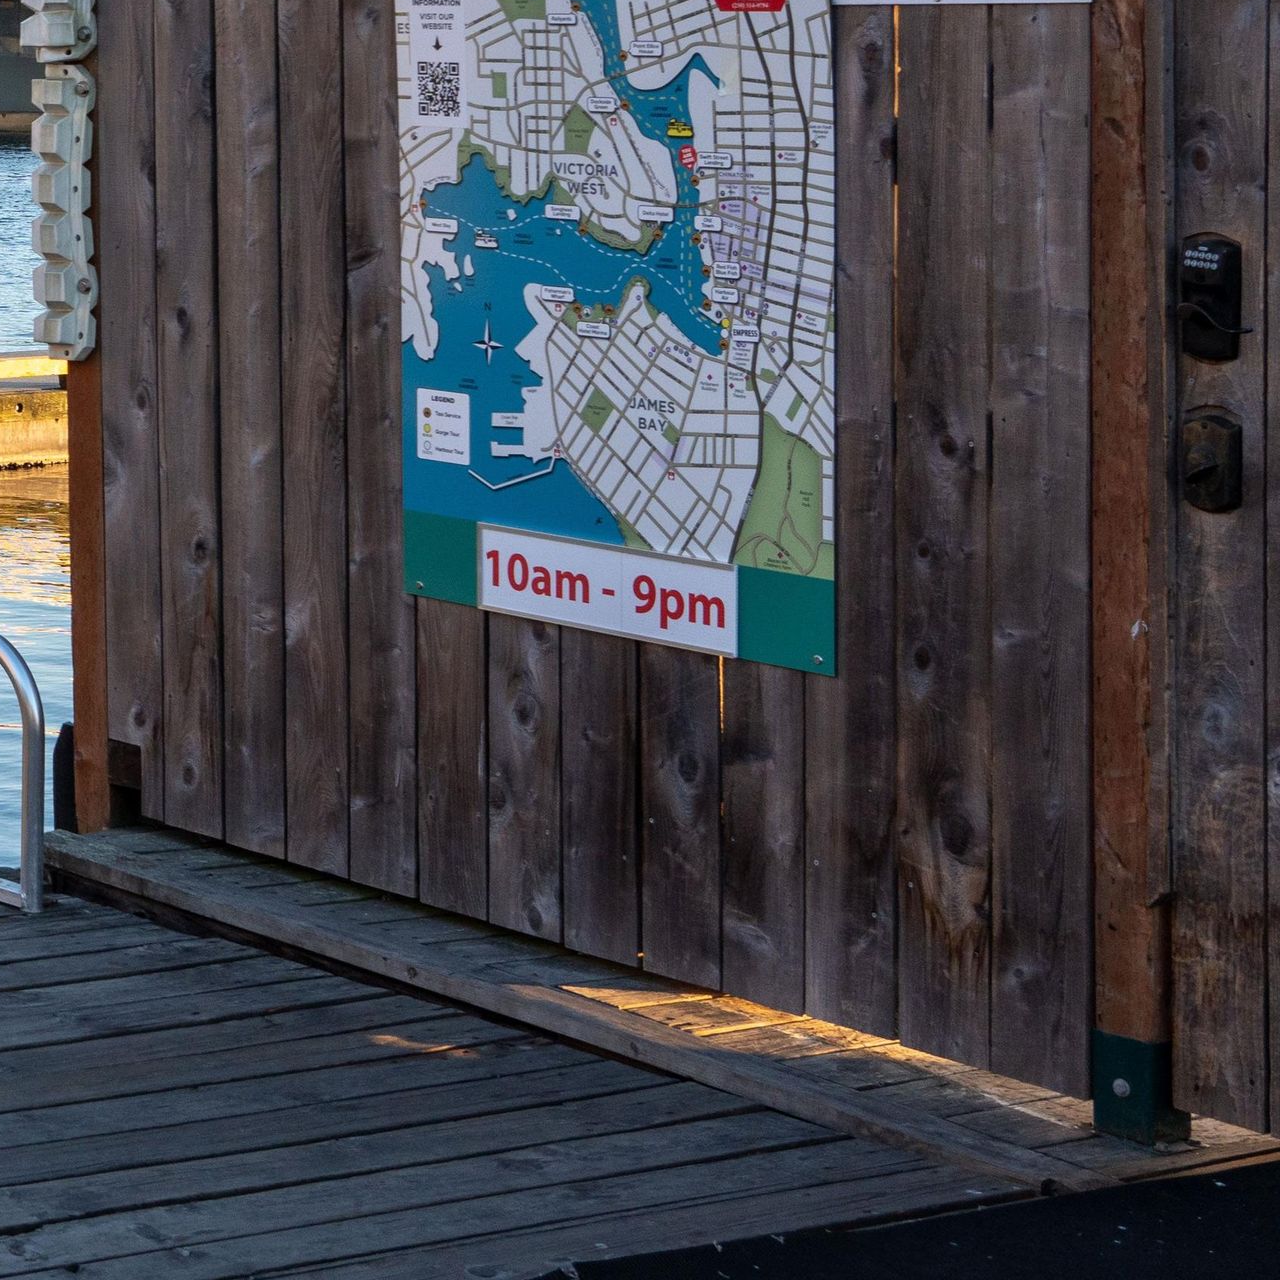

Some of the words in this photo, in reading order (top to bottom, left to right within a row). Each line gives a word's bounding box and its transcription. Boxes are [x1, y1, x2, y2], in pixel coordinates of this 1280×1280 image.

[554, 162, 618, 177] VICTORIA
[568, 182, 606, 195] WEST
[484, 303, 491, 312] N
[732, 328, 759, 338] EMPRESS
[431, 395, 455, 404] LEGEND
[630, 397, 676, 414] JAMES
[638, 417, 668, 431] BAY
[486, 550, 590, 604] 10am
[602, 588, 615, 596] -
[632, 575, 726, 629] 9pm
